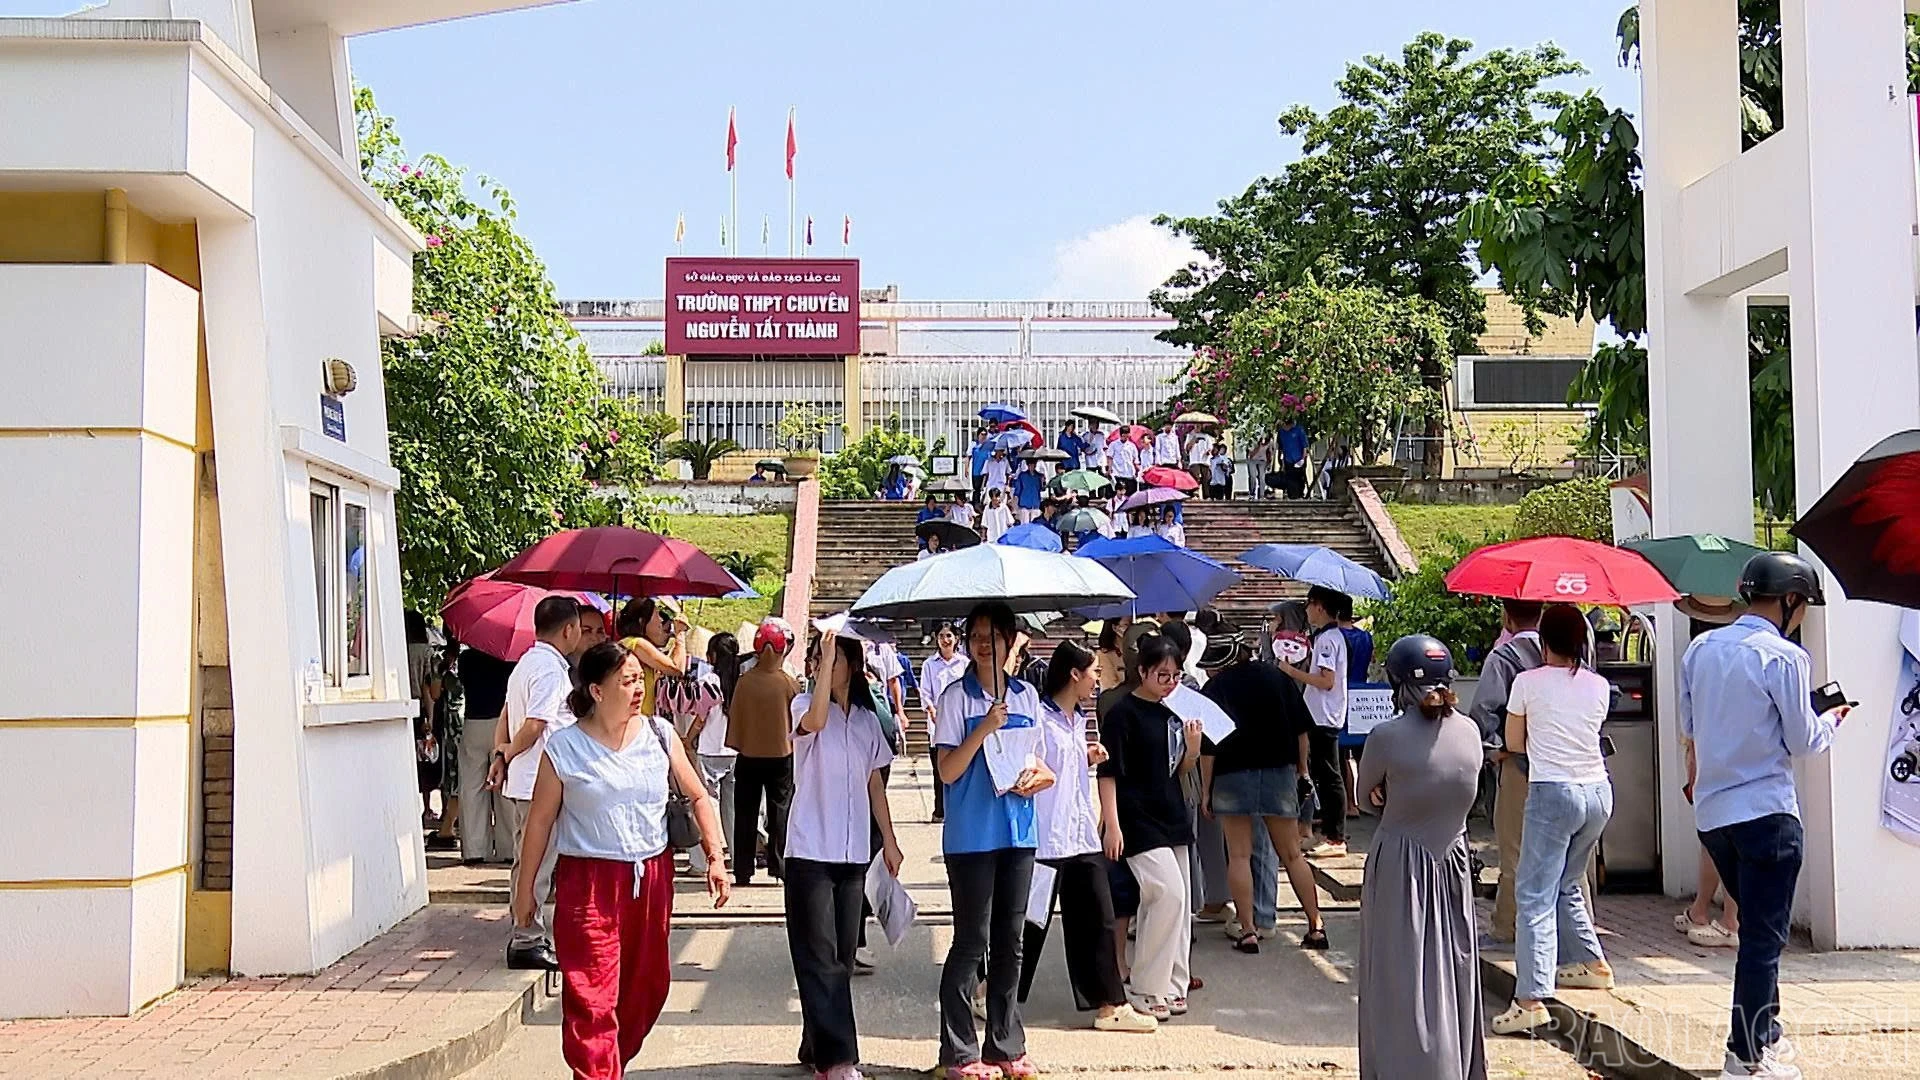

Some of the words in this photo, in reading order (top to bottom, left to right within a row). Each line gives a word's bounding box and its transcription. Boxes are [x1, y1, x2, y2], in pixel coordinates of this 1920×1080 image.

[824, 274, 841, 282] CAI
[676, 291, 739, 312] TRƯỜNG
[743, 295, 783, 312] THPT
[786, 292, 850, 312] CHUYÊN
[686, 315, 751, 338] NGUYỄN
[754, 315, 783, 338] TẤT
[785, 318, 838, 338] THÀNH
